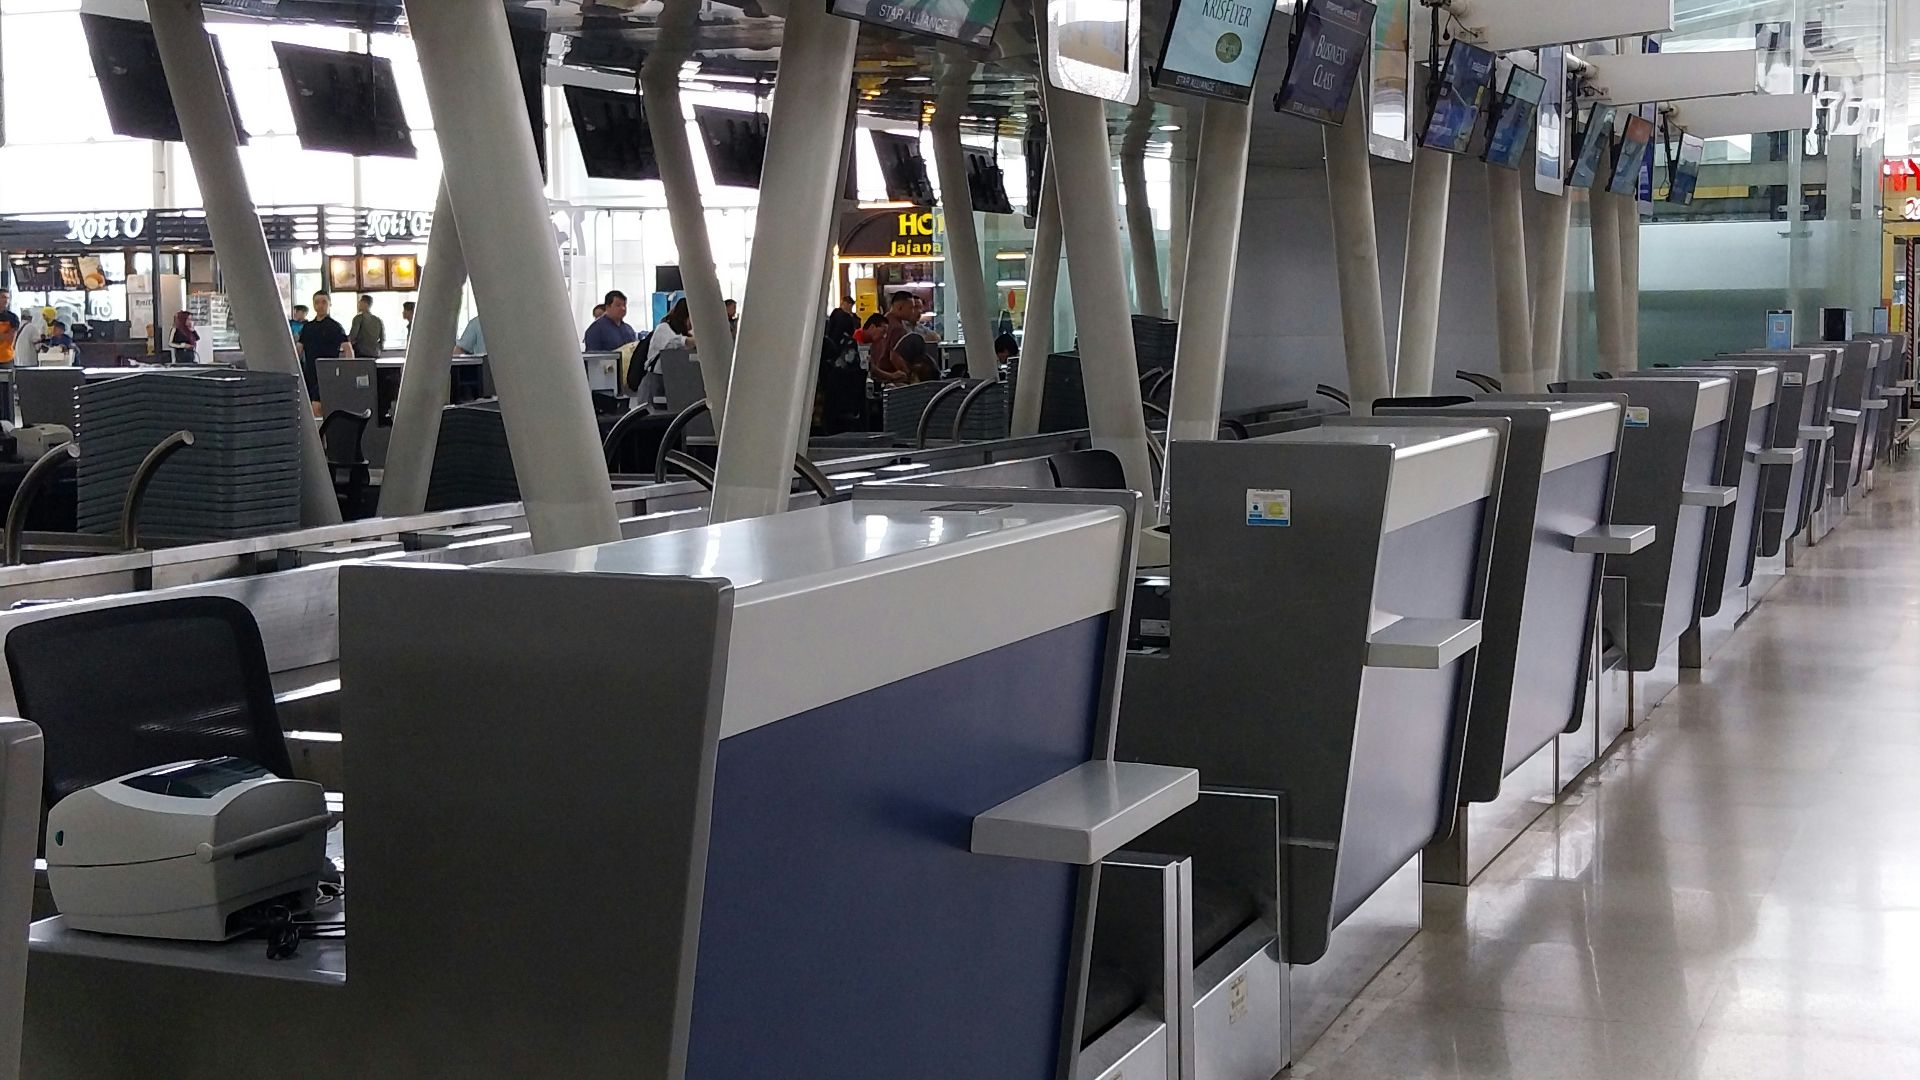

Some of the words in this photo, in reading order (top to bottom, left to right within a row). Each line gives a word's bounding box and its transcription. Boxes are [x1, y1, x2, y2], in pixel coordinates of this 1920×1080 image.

[879, 4, 904, 20] STAR
[904, 10, 948, 32] ALLIANCE
[1202, 0, 1252, 28] KRISFLYER
